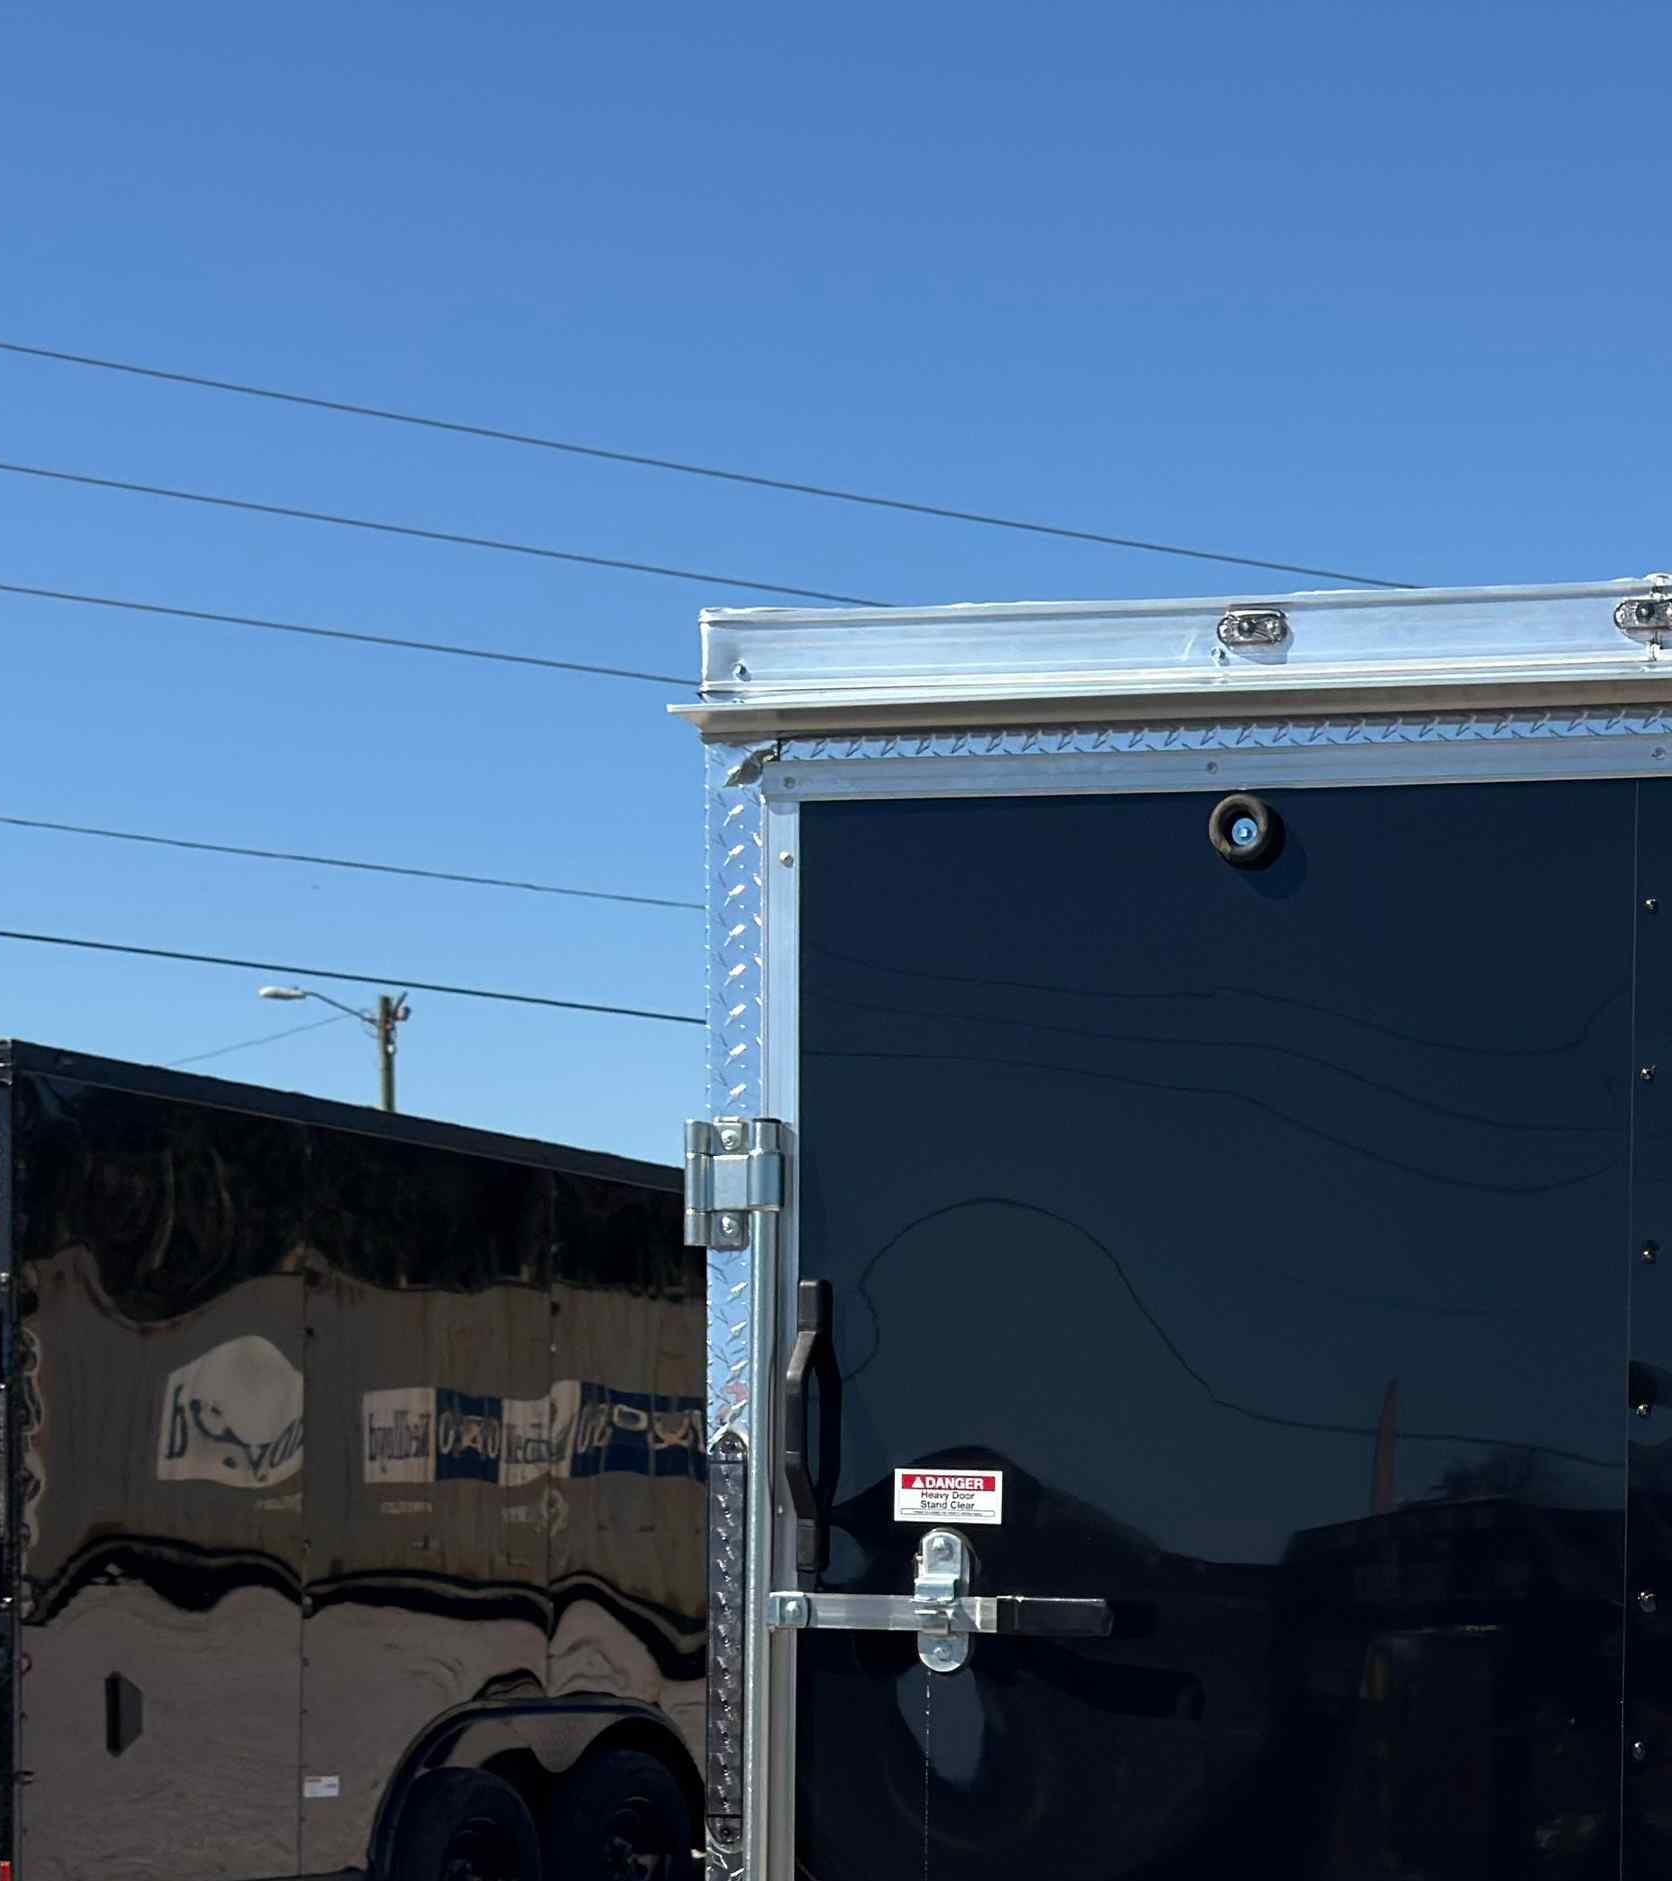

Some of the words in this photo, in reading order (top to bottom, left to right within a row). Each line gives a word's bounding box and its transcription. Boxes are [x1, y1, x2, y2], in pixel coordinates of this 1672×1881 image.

[925, 1476, 984, 1490] DANGER
[920, 1491, 949, 1500] Heavy
[920, 1500, 948, 1509] Stand
[950, 1501, 975, 1510] Clear
